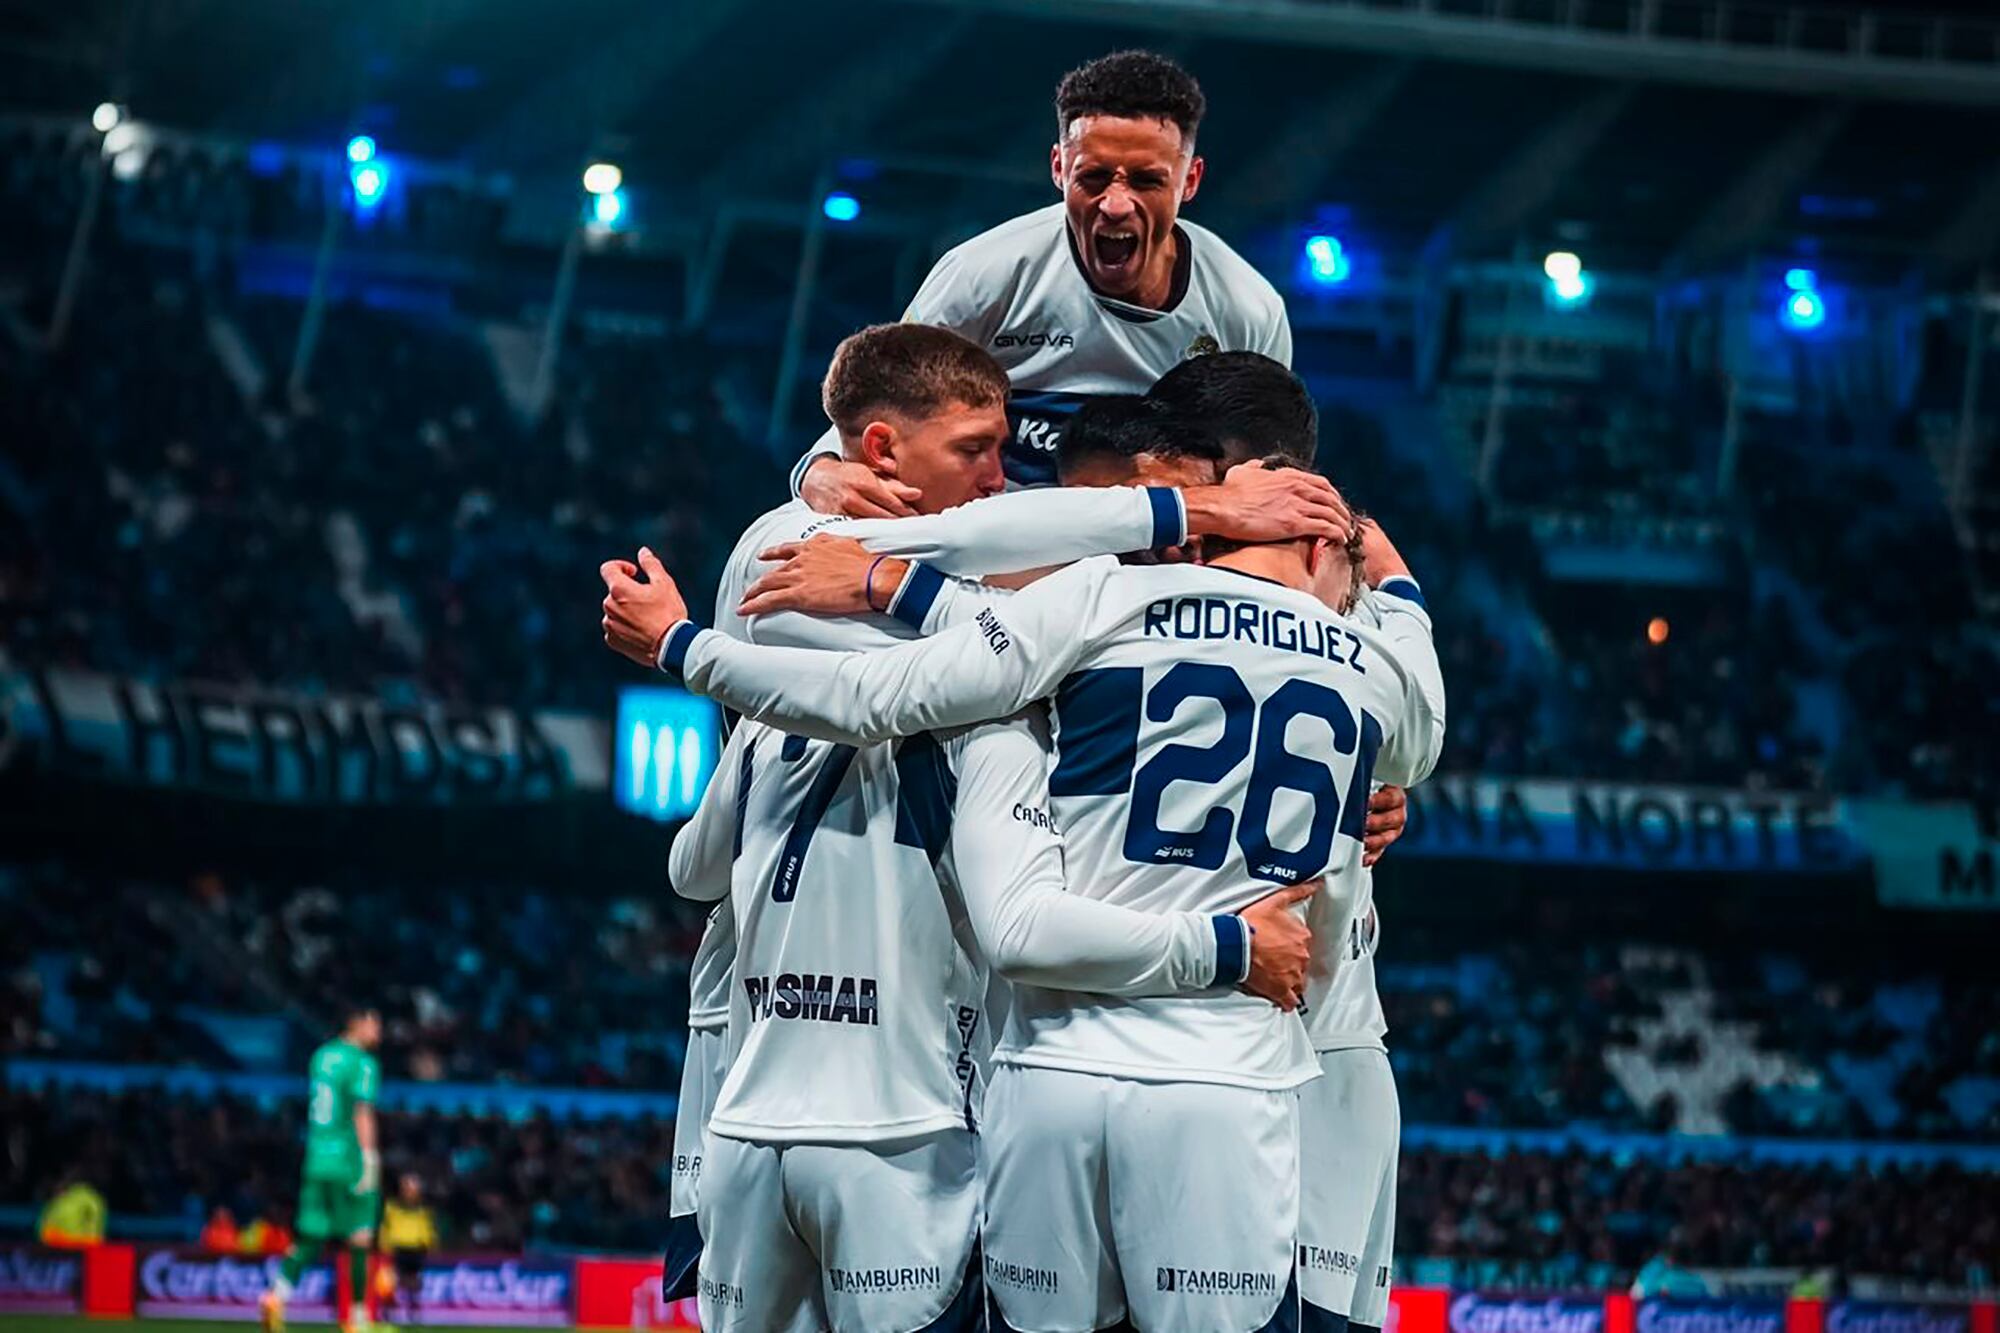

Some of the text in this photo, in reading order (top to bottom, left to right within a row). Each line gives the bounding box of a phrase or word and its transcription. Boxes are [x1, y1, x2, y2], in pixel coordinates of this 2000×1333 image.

[994, 333, 1074, 348] GIVOVA
[1144, 597, 1366, 675] RODRIGUEZ
[1122, 661, 1358, 887] 26
[1573, 782, 1842, 866] NORTE
[1172, 848, 1194, 858] RUS
[785, 855, 797, 881] RUS
[1273, 866, 1297, 880] RUS
[1177, 1269, 1276, 1291] TAMBURINI
